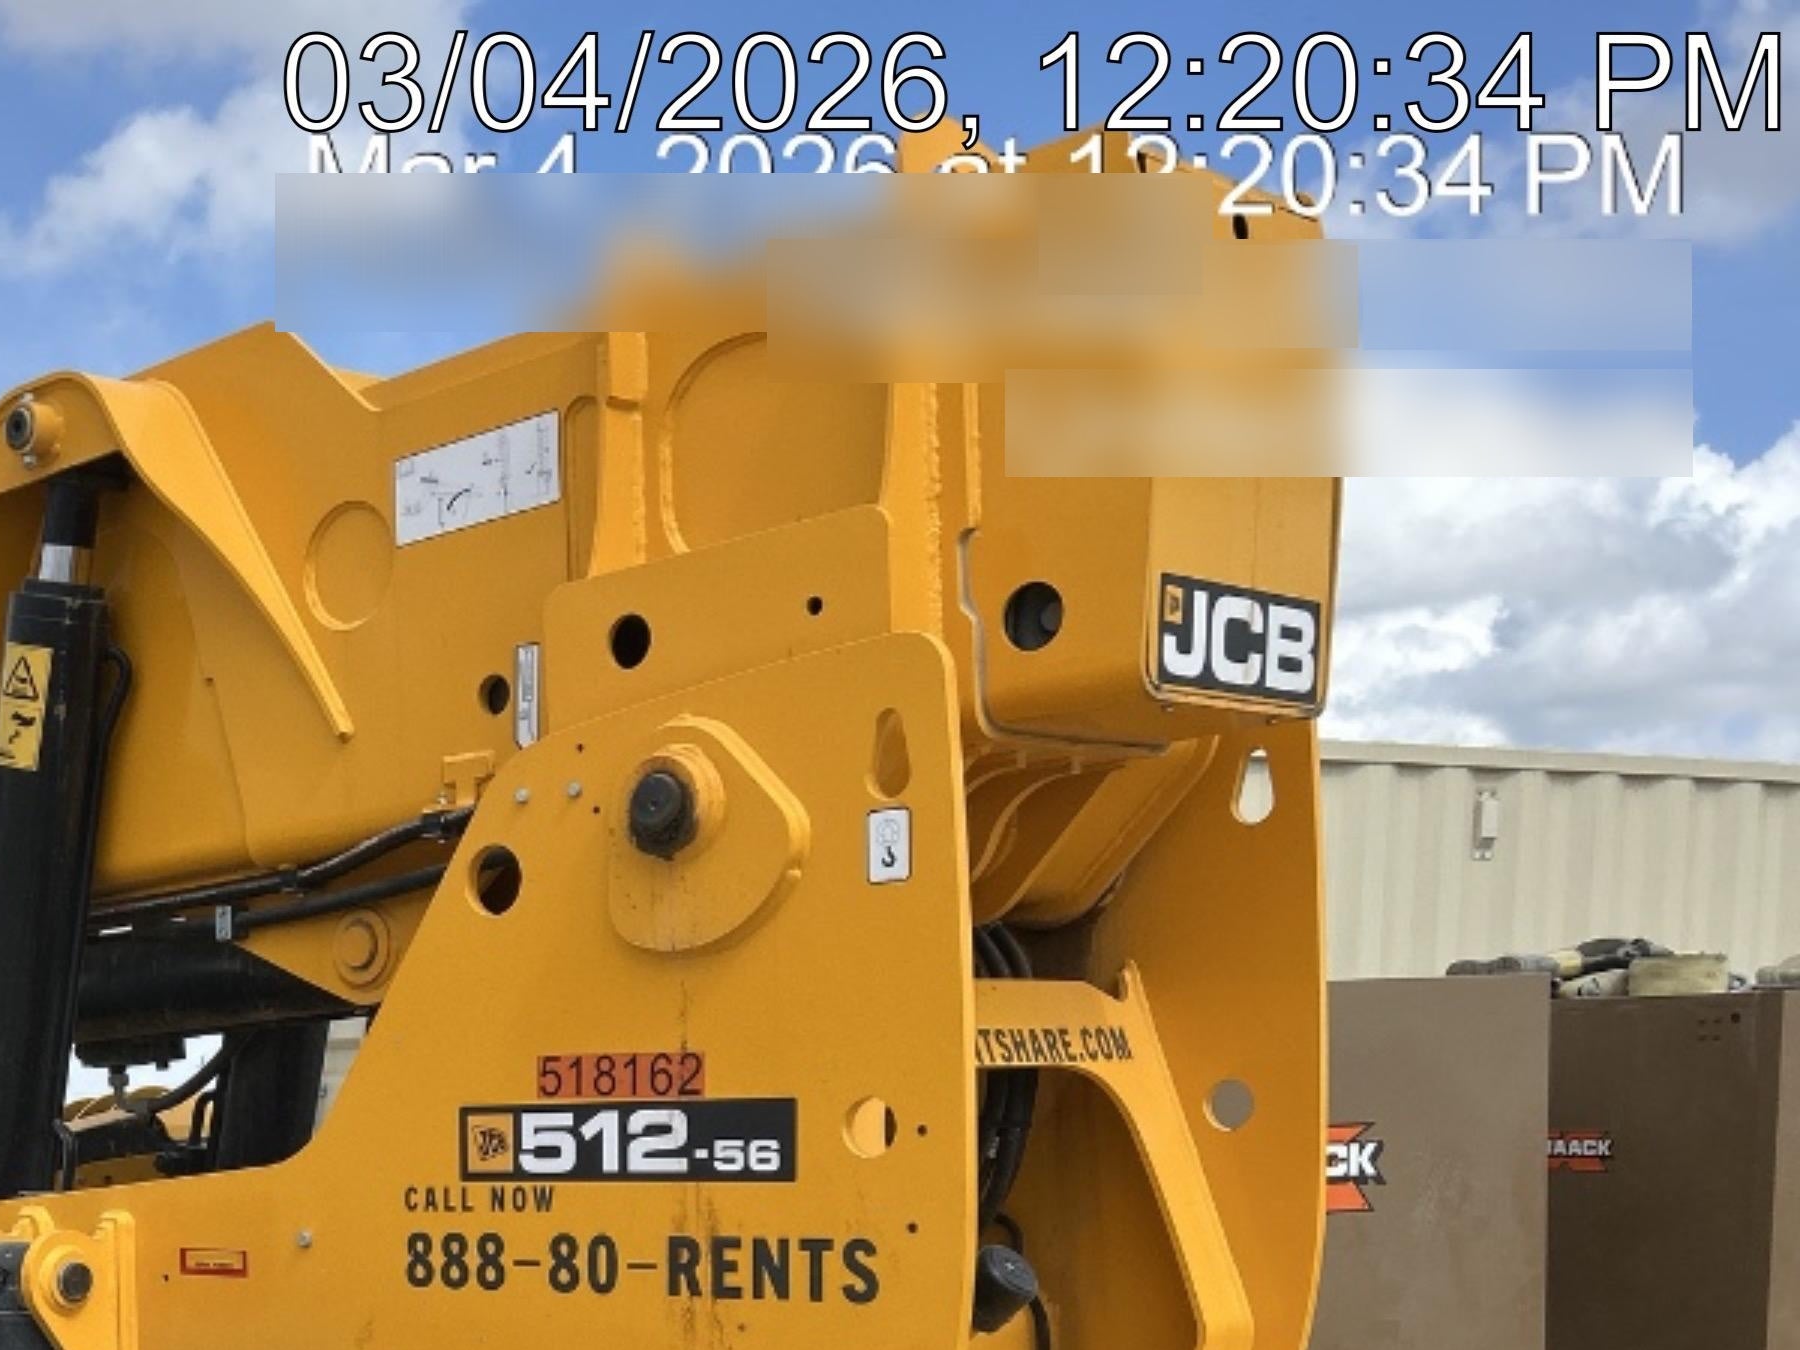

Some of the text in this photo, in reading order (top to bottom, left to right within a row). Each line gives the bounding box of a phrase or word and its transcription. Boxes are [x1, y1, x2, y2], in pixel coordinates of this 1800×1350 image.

[1163, 589, 1317, 694] JCB
[538, 1053, 702, 1097] 518162
[404, 1185, 556, 1213] CALL NOW
[405, 1231, 880, 1305] 888-80-RENTS
